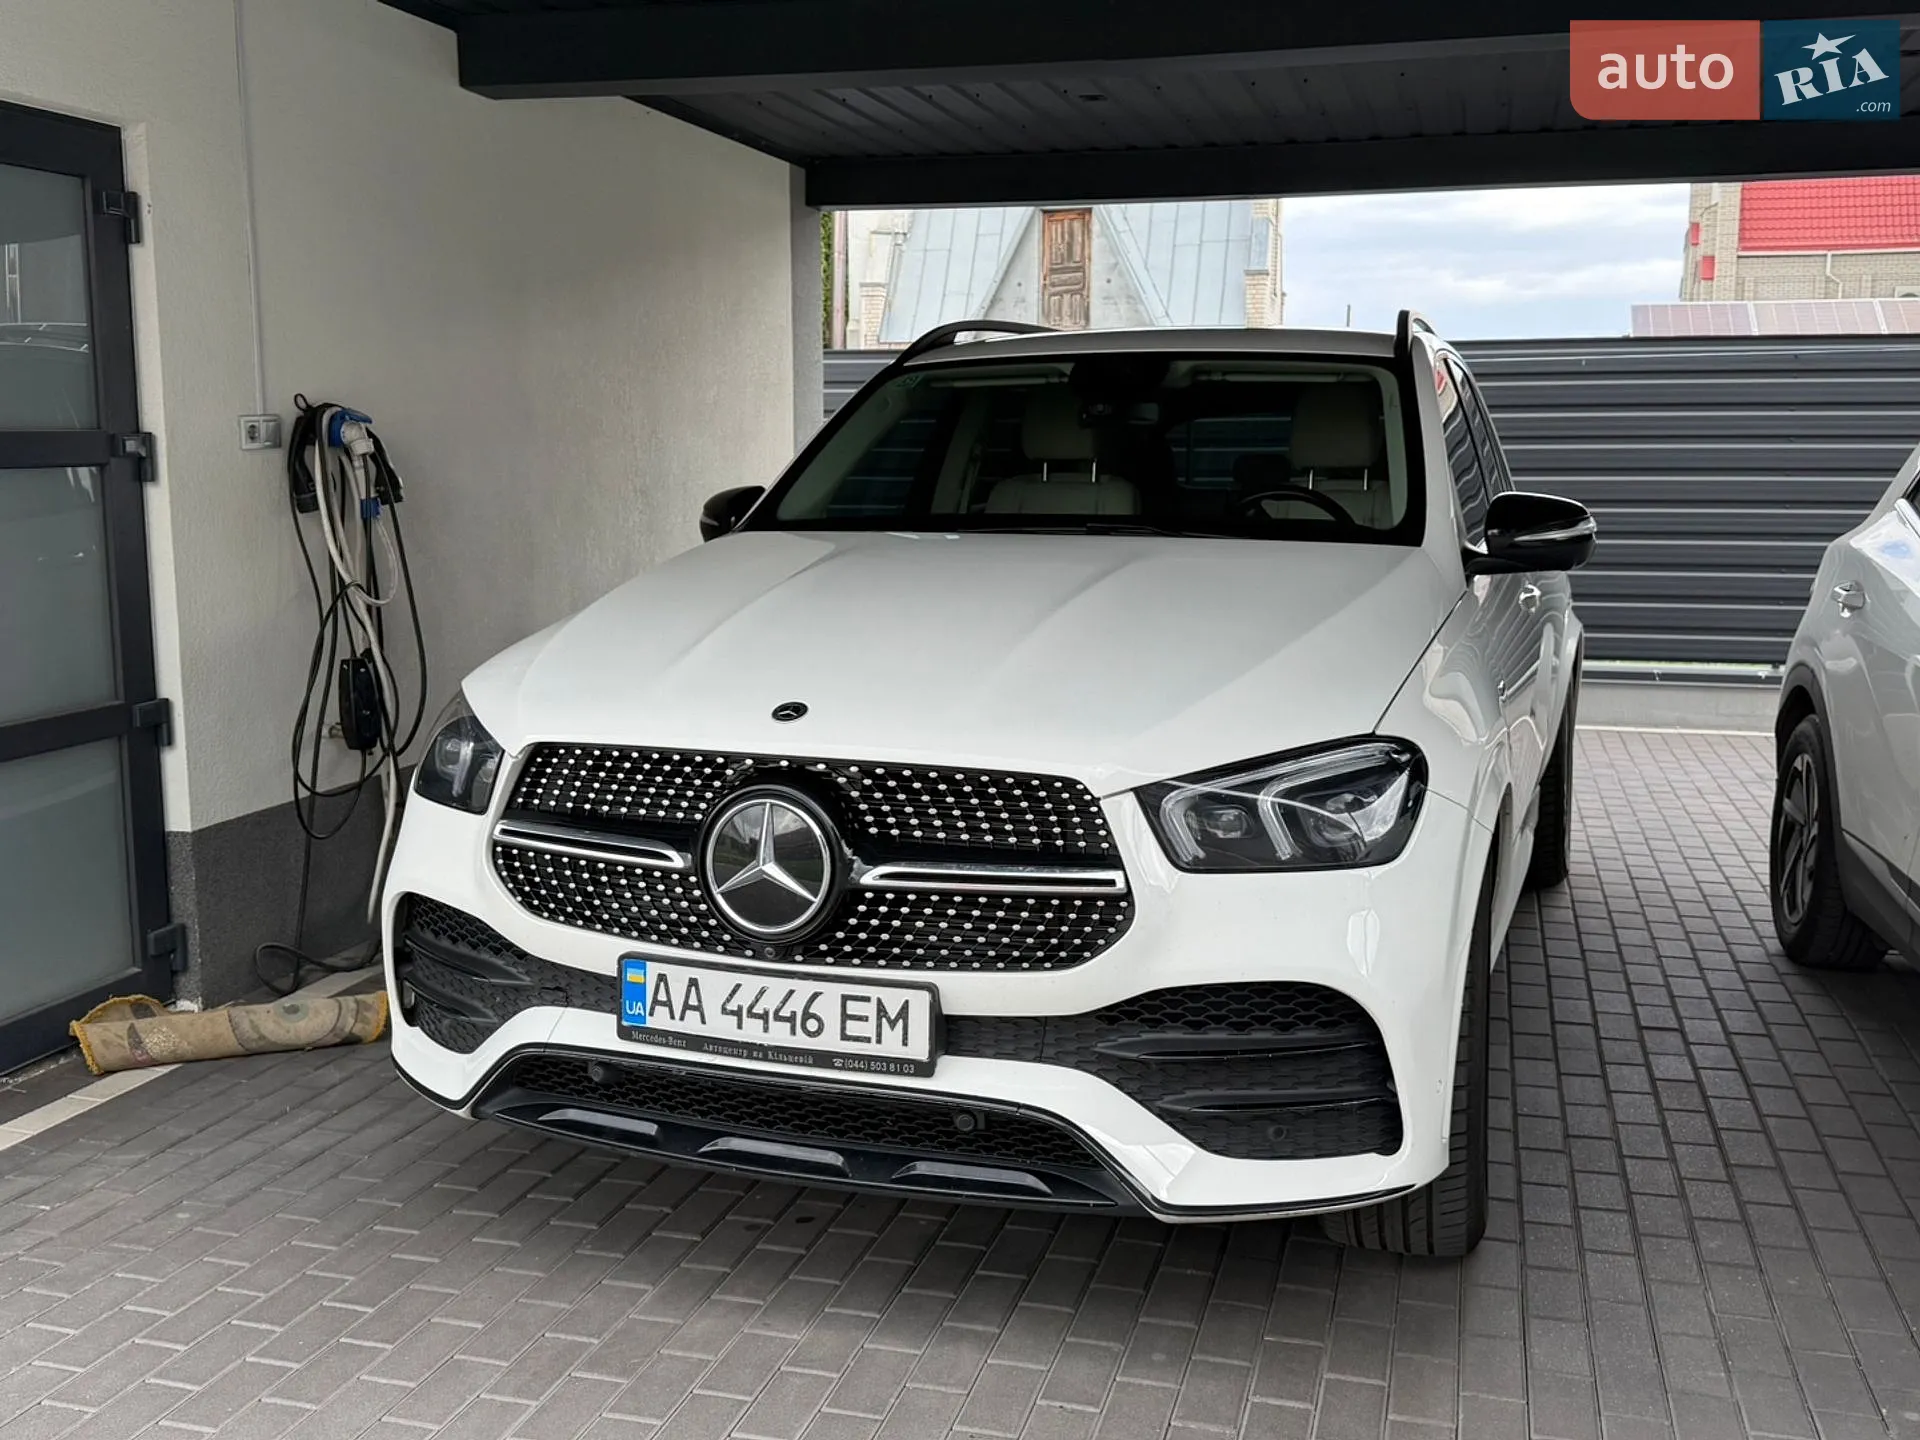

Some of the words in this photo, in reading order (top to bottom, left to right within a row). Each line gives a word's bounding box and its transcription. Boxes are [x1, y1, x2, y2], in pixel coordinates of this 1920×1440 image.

[625, 1000, 645, 1017] UA
[648, 972, 707, 1025] AA
[721, 983, 825, 1039] 4446
[839, 993, 910, 1047] EM
[631, 1030, 687, 1047] Mercedes-Benz
[844, 1058, 868, 1070] (044)
[870, 1062, 887, 1072] 503
[889, 1063, 900, 1072] 81
[902, 1064, 915, 1073] 03
